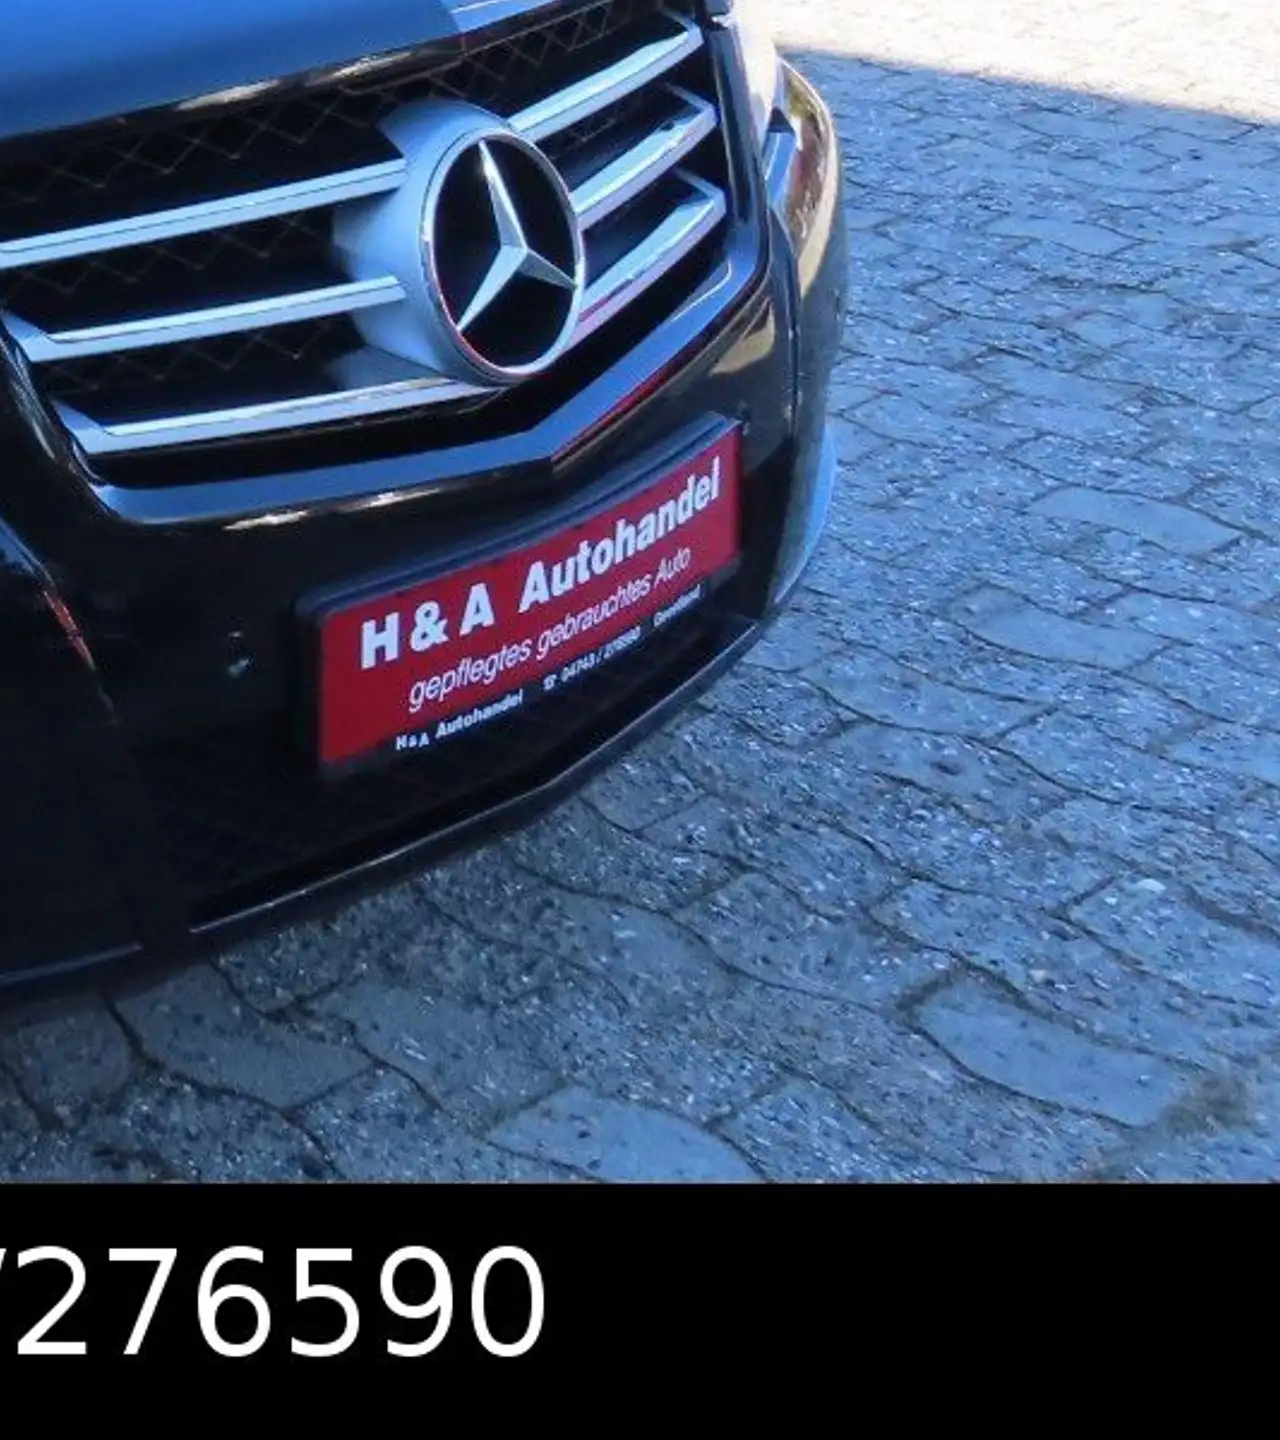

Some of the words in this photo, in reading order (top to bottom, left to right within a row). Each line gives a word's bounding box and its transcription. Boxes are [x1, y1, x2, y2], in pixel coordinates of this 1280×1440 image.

[517, 456, 721, 614] Autohandel
[408, 635, 532, 713] gepflegtes
[536, 574, 652, 660] gebrauchtes
[654, 546, 691, 588] Auto
[434, 688, 524, 740] Autohandel
